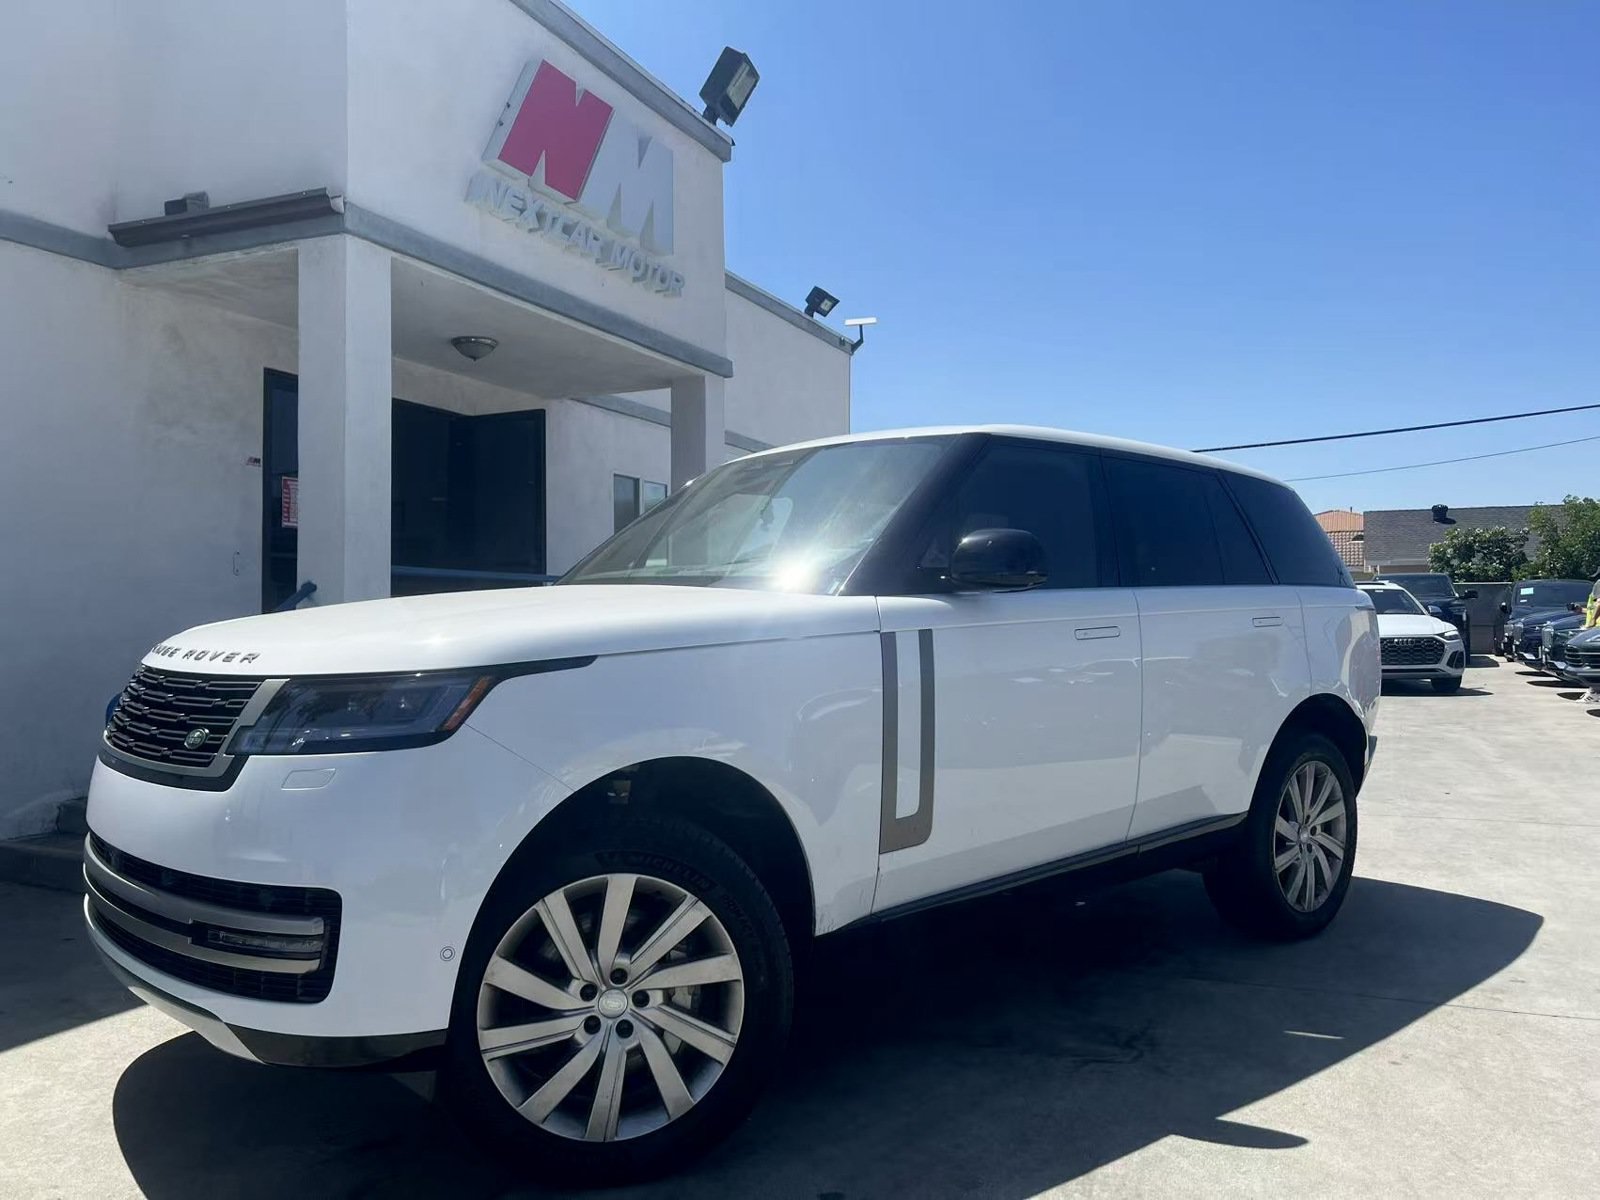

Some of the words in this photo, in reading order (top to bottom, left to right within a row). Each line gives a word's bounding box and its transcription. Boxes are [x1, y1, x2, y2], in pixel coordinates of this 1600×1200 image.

[464, 170, 604, 258] NEXTCAR
[607, 242, 686, 296] MOTOR
[182, 649, 261, 664] ROVER
